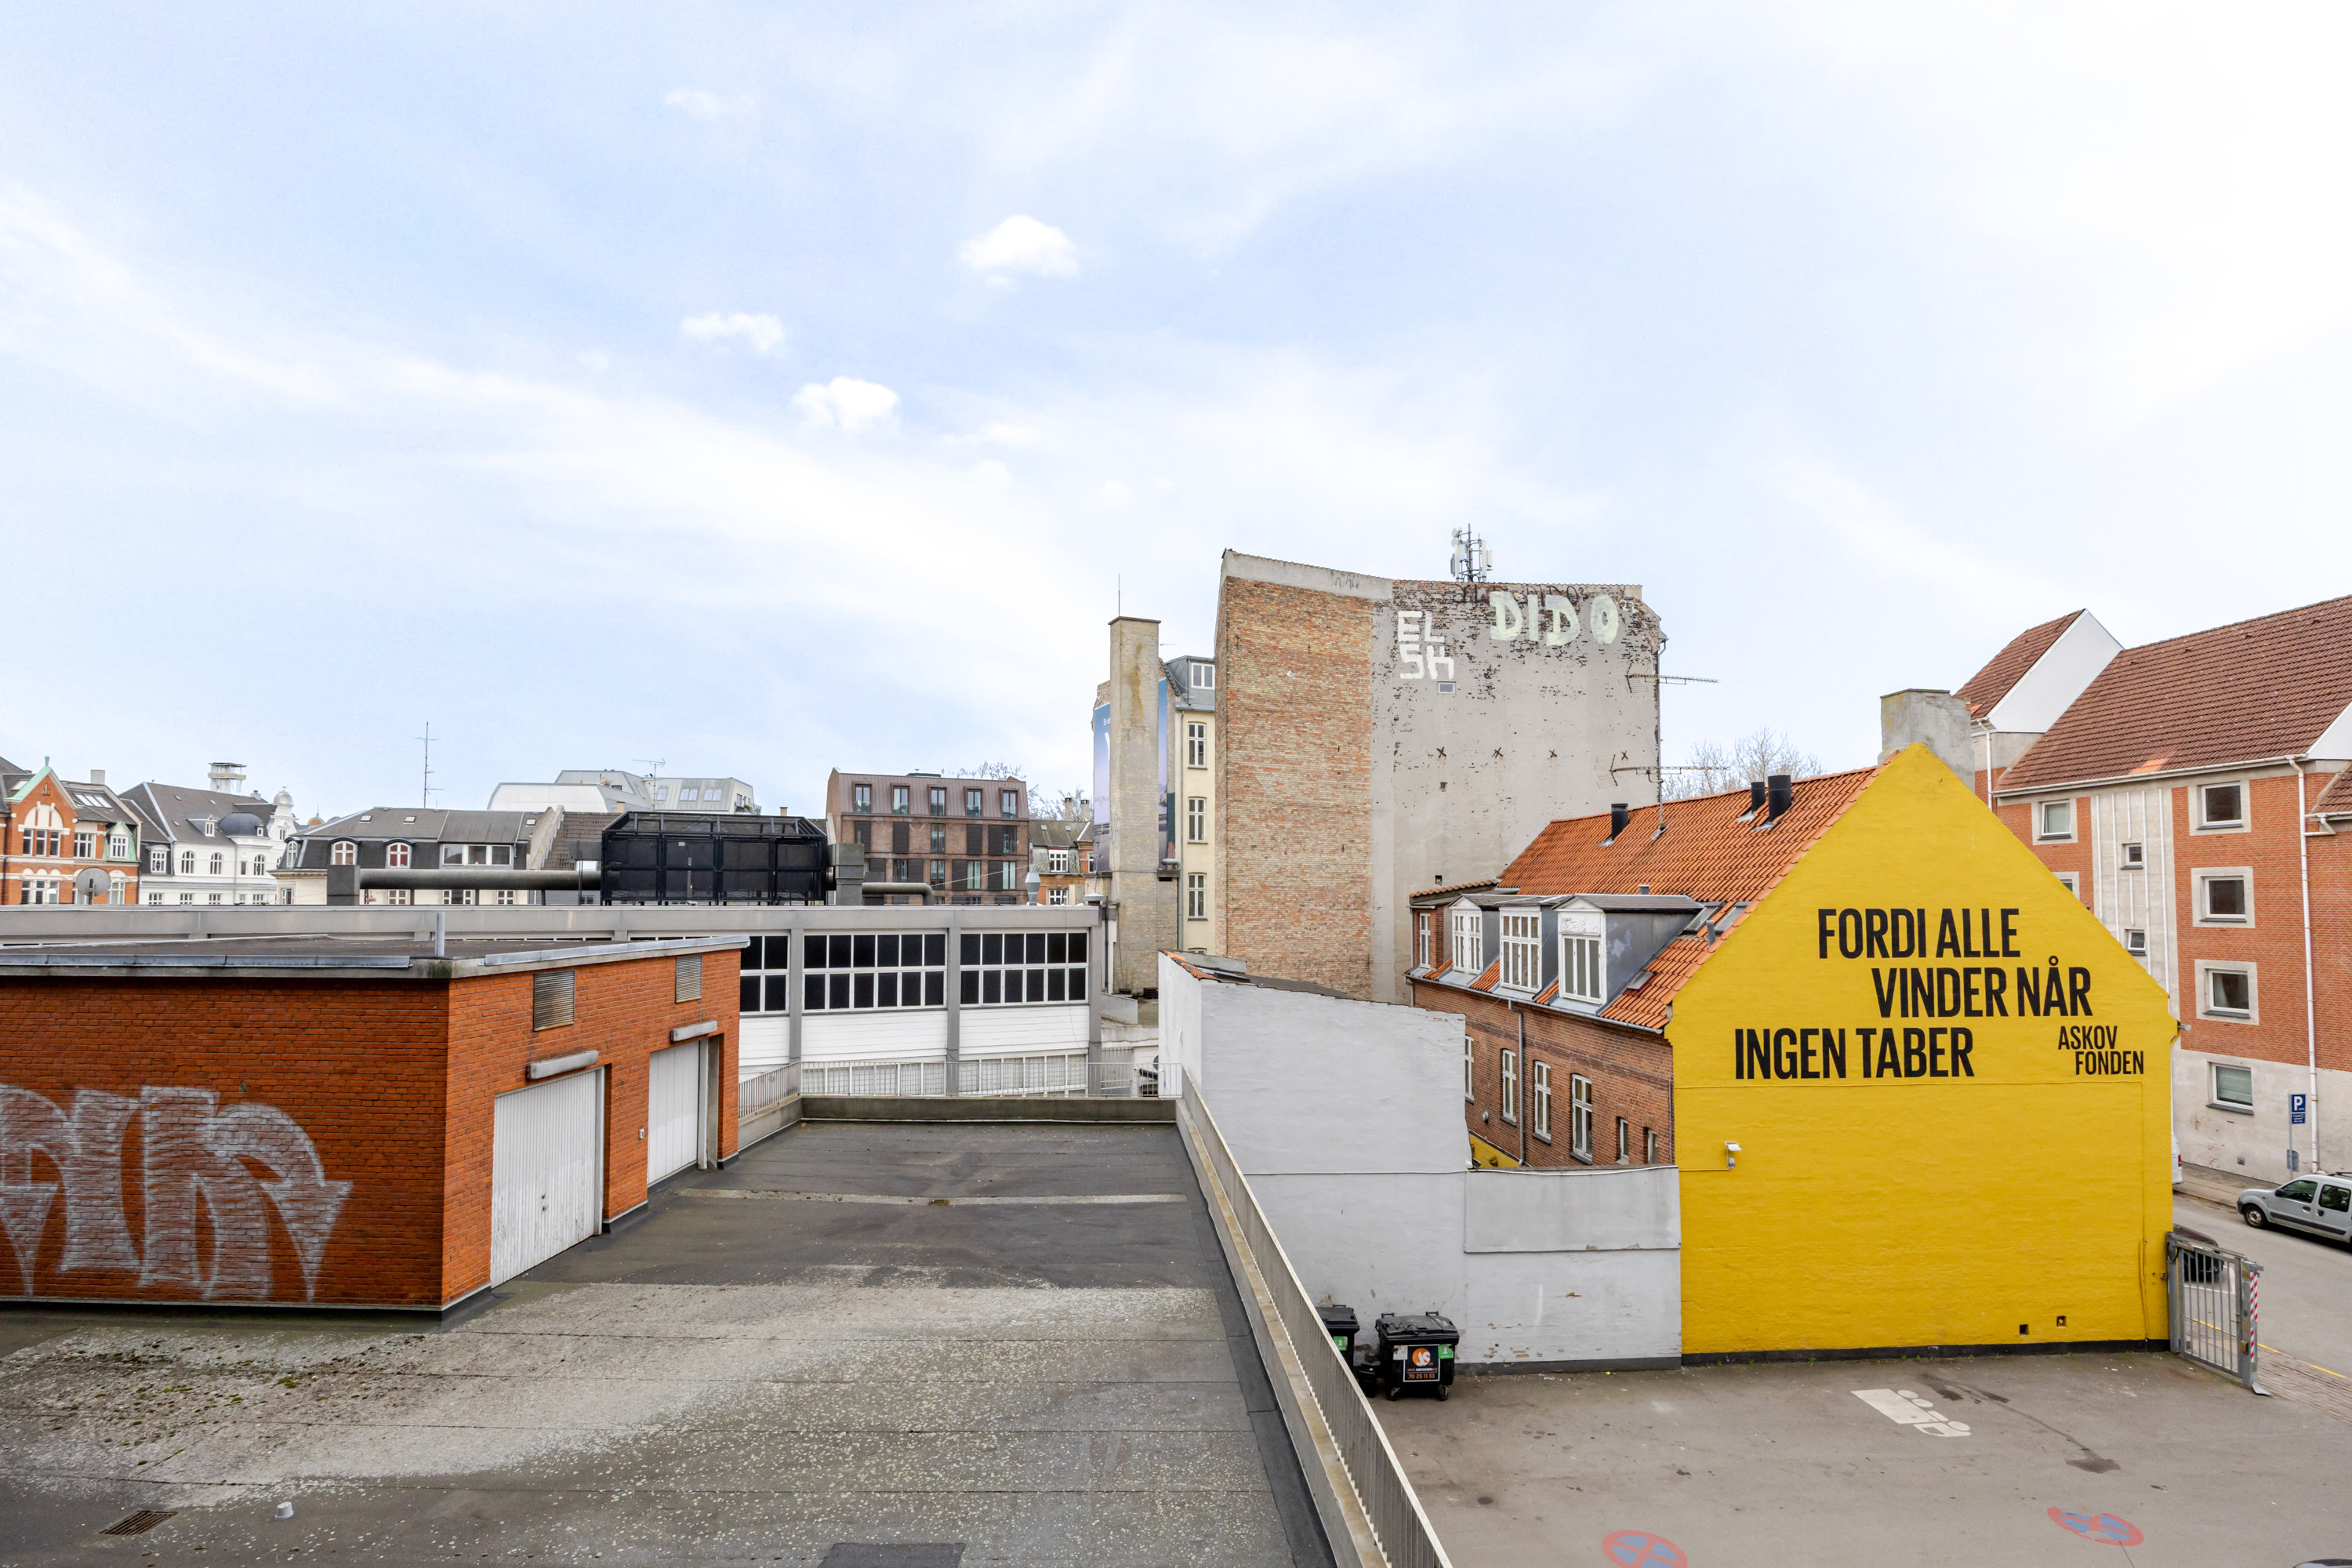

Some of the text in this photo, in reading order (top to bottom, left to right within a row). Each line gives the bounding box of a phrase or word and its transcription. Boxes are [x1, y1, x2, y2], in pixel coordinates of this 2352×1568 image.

[1398, 611, 1445, 642] EL
[1490, 591, 1619, 646] DIDO
[1818, 909, 2020, 959] FORDI ALLE
[1871, 955, 2092, 1018] VINDER NÅR
[1736, 1028, 1974, 1079] INGEN TABER
[2058, 1025, 2118, 1050] ASKOV
[2075, 1051, 2143, 1075] FONDEN
[2294, 1096, 2303, 1111] P
